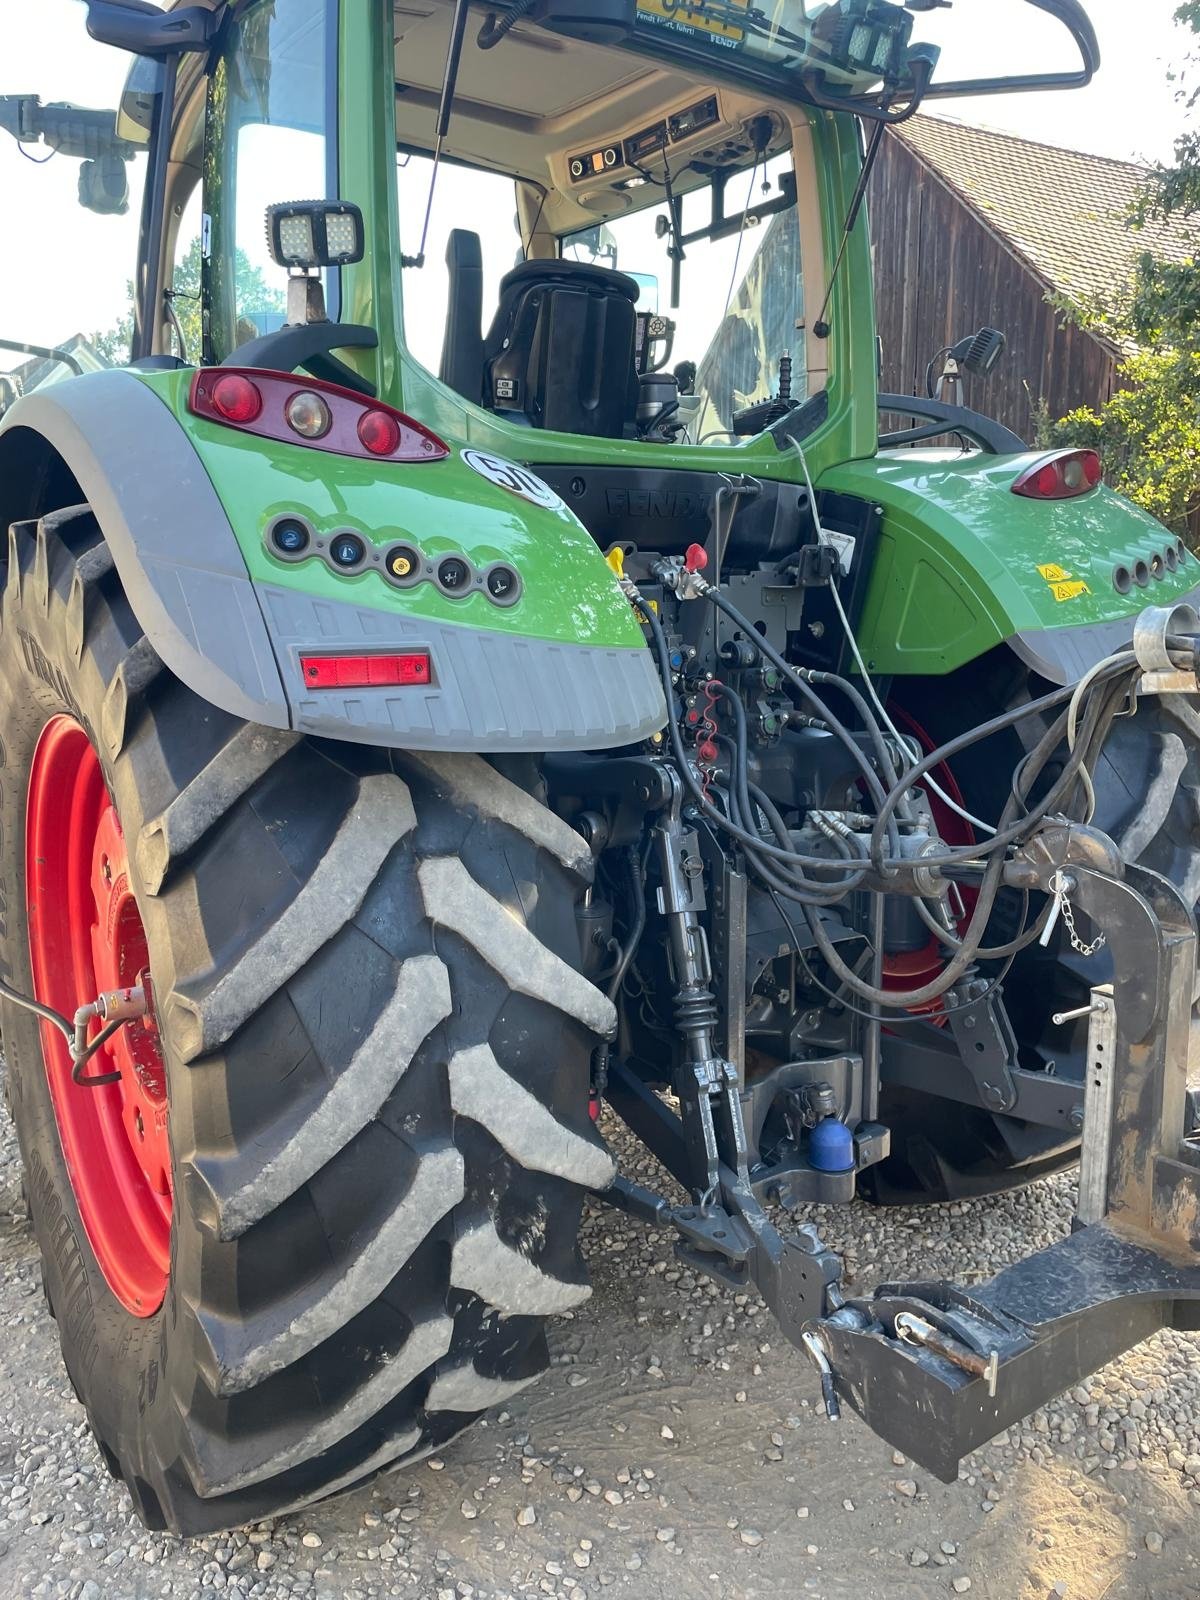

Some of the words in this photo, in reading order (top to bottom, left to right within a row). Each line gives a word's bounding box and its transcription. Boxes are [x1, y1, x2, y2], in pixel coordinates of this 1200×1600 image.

[636, 11, 655, 23] Fendt
[710, 34, 739, 49] FENDT
[474, 454, 550, 500] 50
